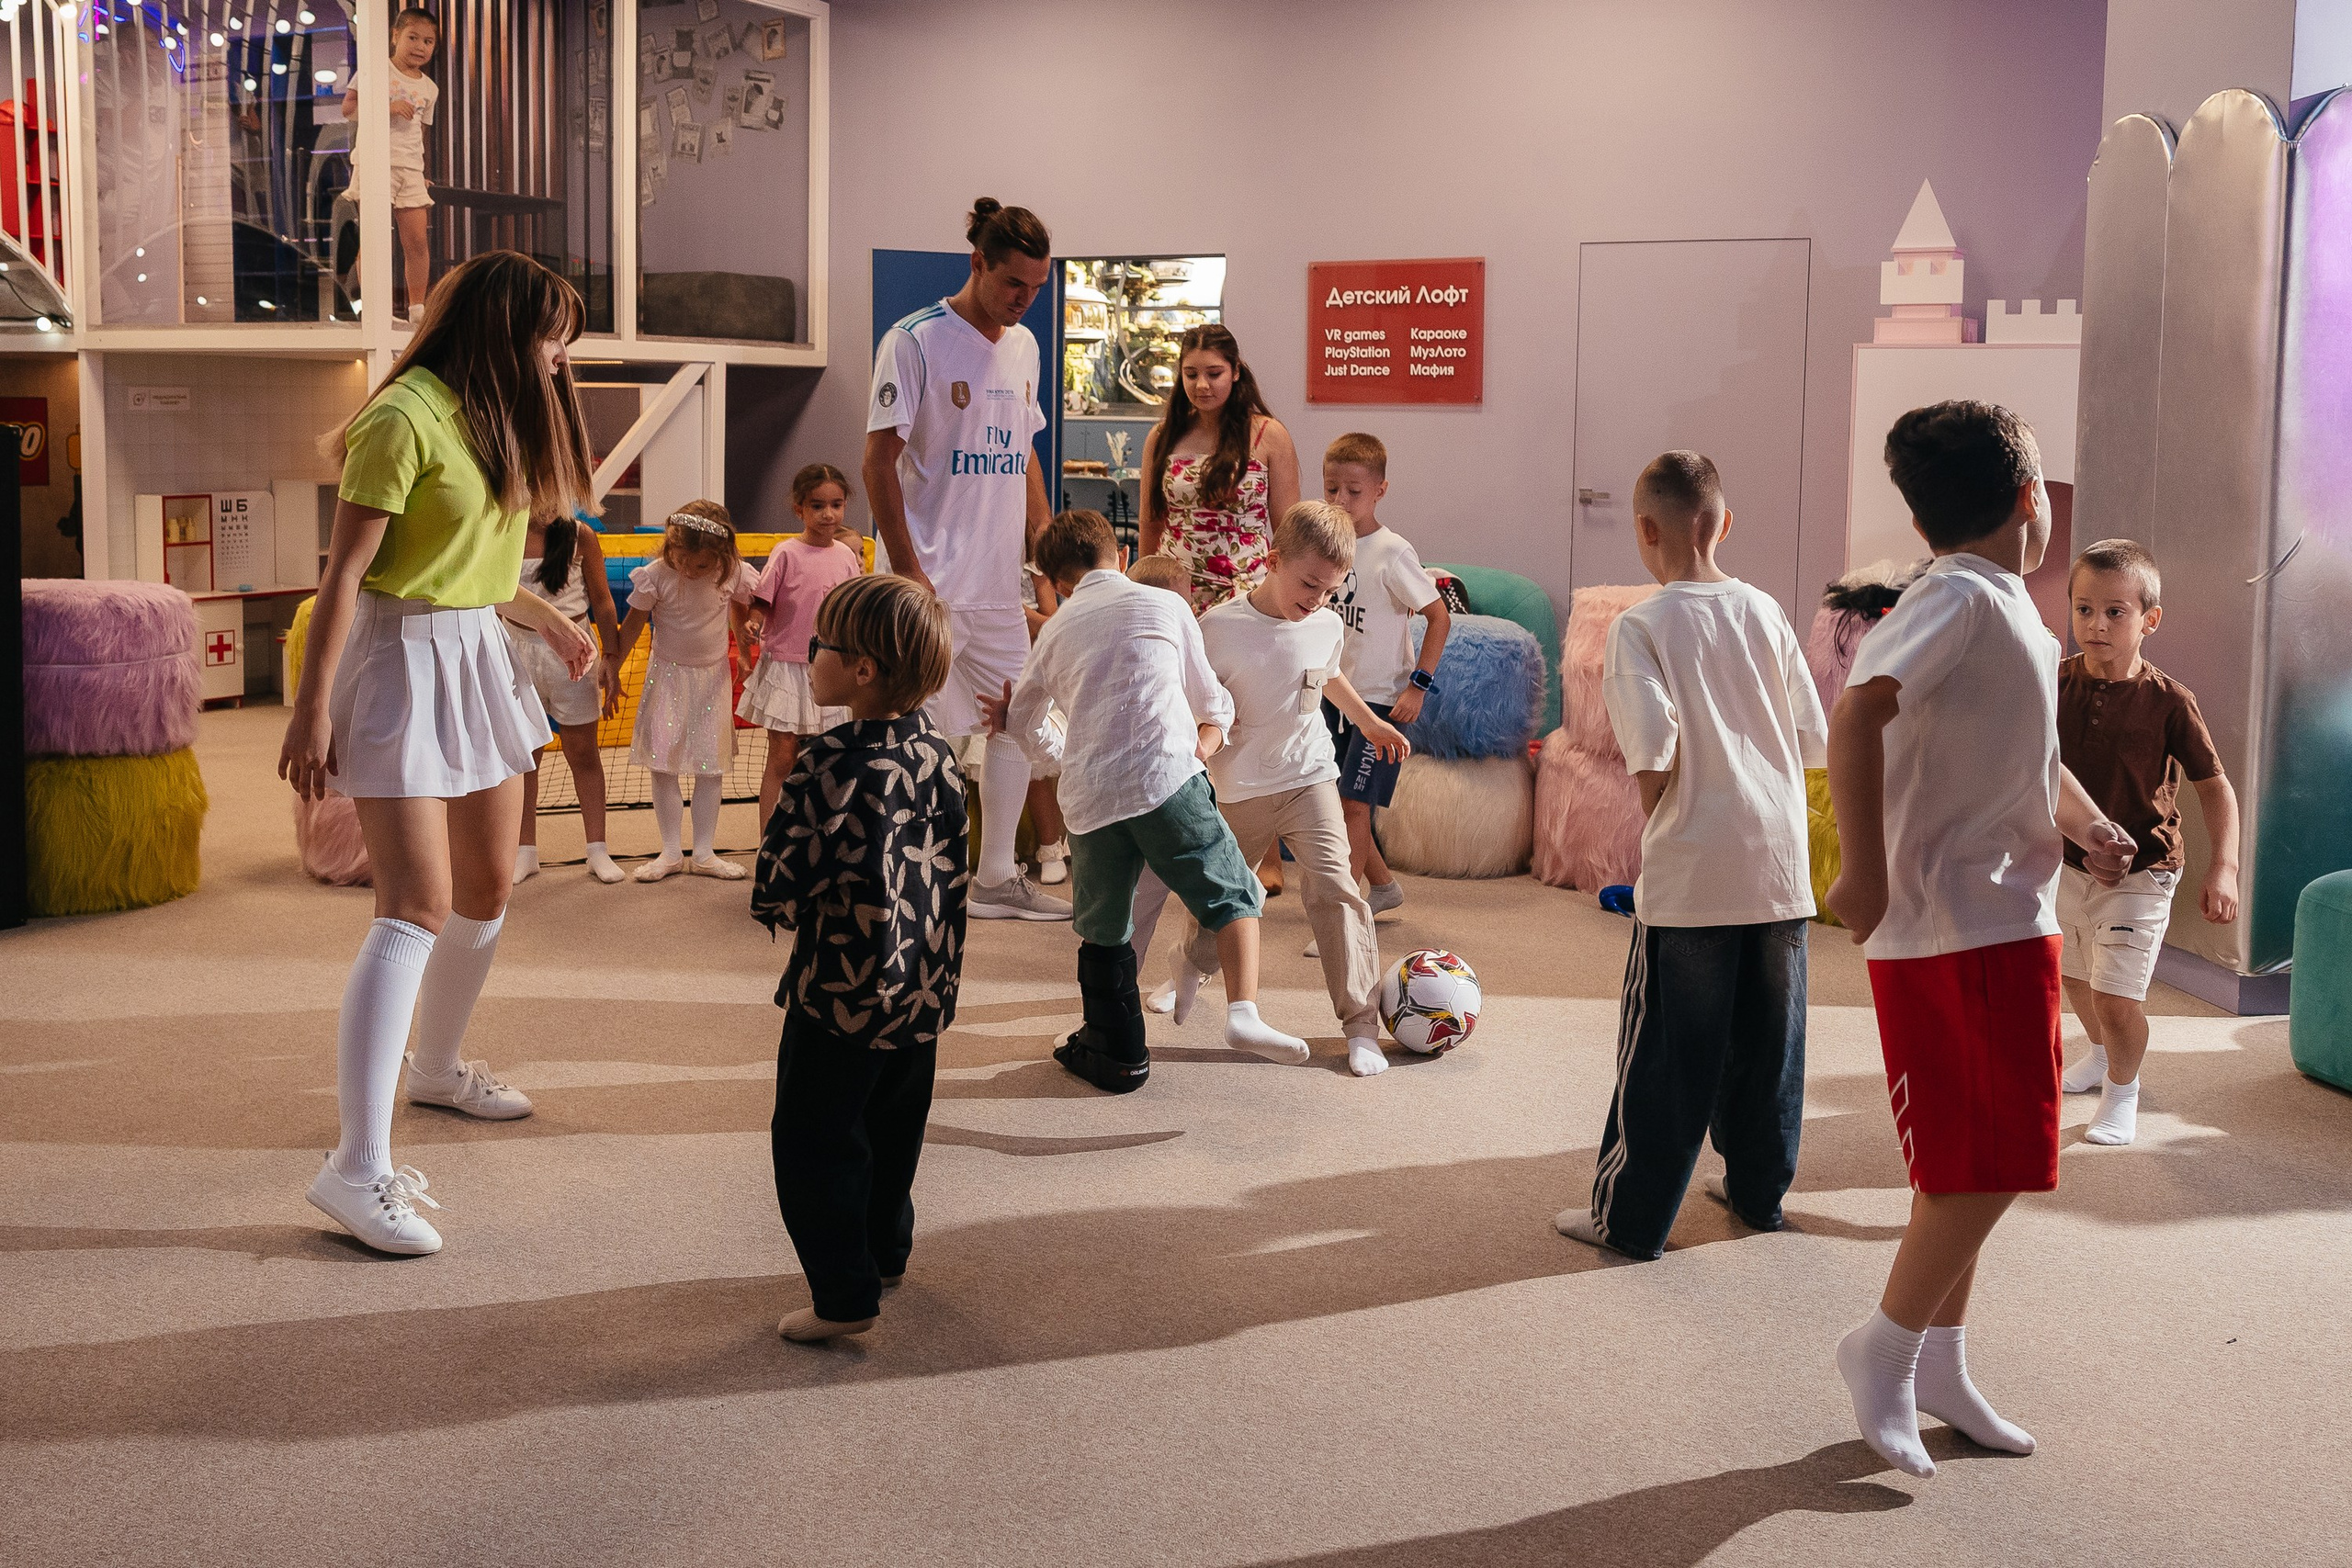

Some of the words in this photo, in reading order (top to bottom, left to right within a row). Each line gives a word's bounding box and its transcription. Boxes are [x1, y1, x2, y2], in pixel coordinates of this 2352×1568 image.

[1325, 286, 1411, 309] Детский
[1415, 285, 1469, 307] Лофт
[1324, 328, 1341, 341] VR
[1343, 330, 1386, 344] games
[1410, 327, 1468, 343] Караоке
[1325, 345, 1391, 361] PlayStation
[1409, 345, 1467, 360] МузЛото
[1324, 364, 1348, 377] Just
[1350, 364, 1391, 377] Dance
[1409, 363, 1455, 378] Мафия
[987, 425, 1012, 449] Fly
[951, 447, 1027, 476] Emirate
[1331, 604, 1366, 634] GUE
[1357, 741, 1376, 777] AYCAY
